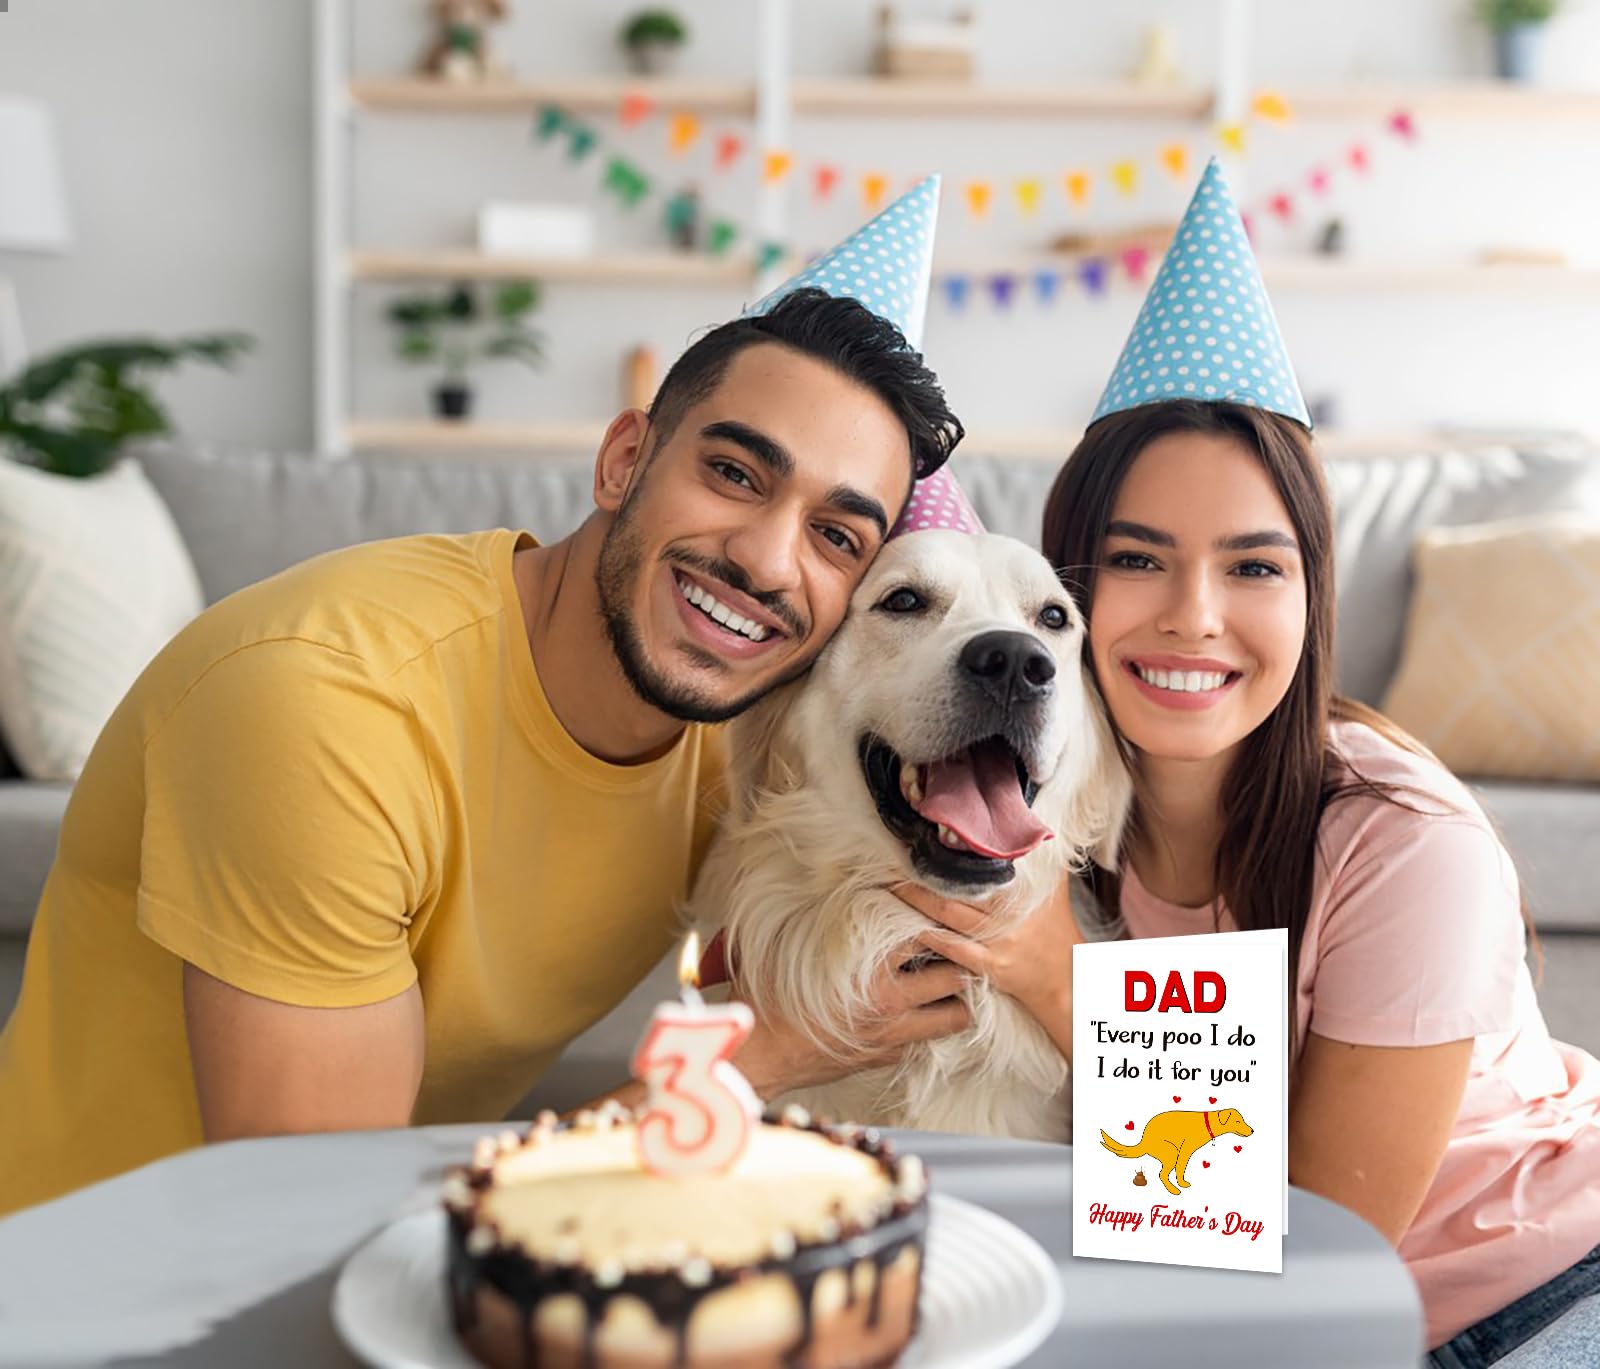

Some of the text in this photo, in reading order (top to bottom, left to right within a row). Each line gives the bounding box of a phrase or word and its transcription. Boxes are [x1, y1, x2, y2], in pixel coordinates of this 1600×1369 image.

[1124, 970, 1227, 1014] DAD
[1162, 1031, 1202, 1052] poo
[1210, 1023, 1219, 1047] I
[1227, 1024, 1256, 1047] do
[1097, 1056, 1105, 1079] I
[1112, 1057, 1140, 1079] do
[1148, 1058, 1164, 1081] it
[1170, 1060, 1202, 1081] for
[631, 1002, 759, 1179] 3
[1089, 1202, 1265, 1242] Happy Father's Day
